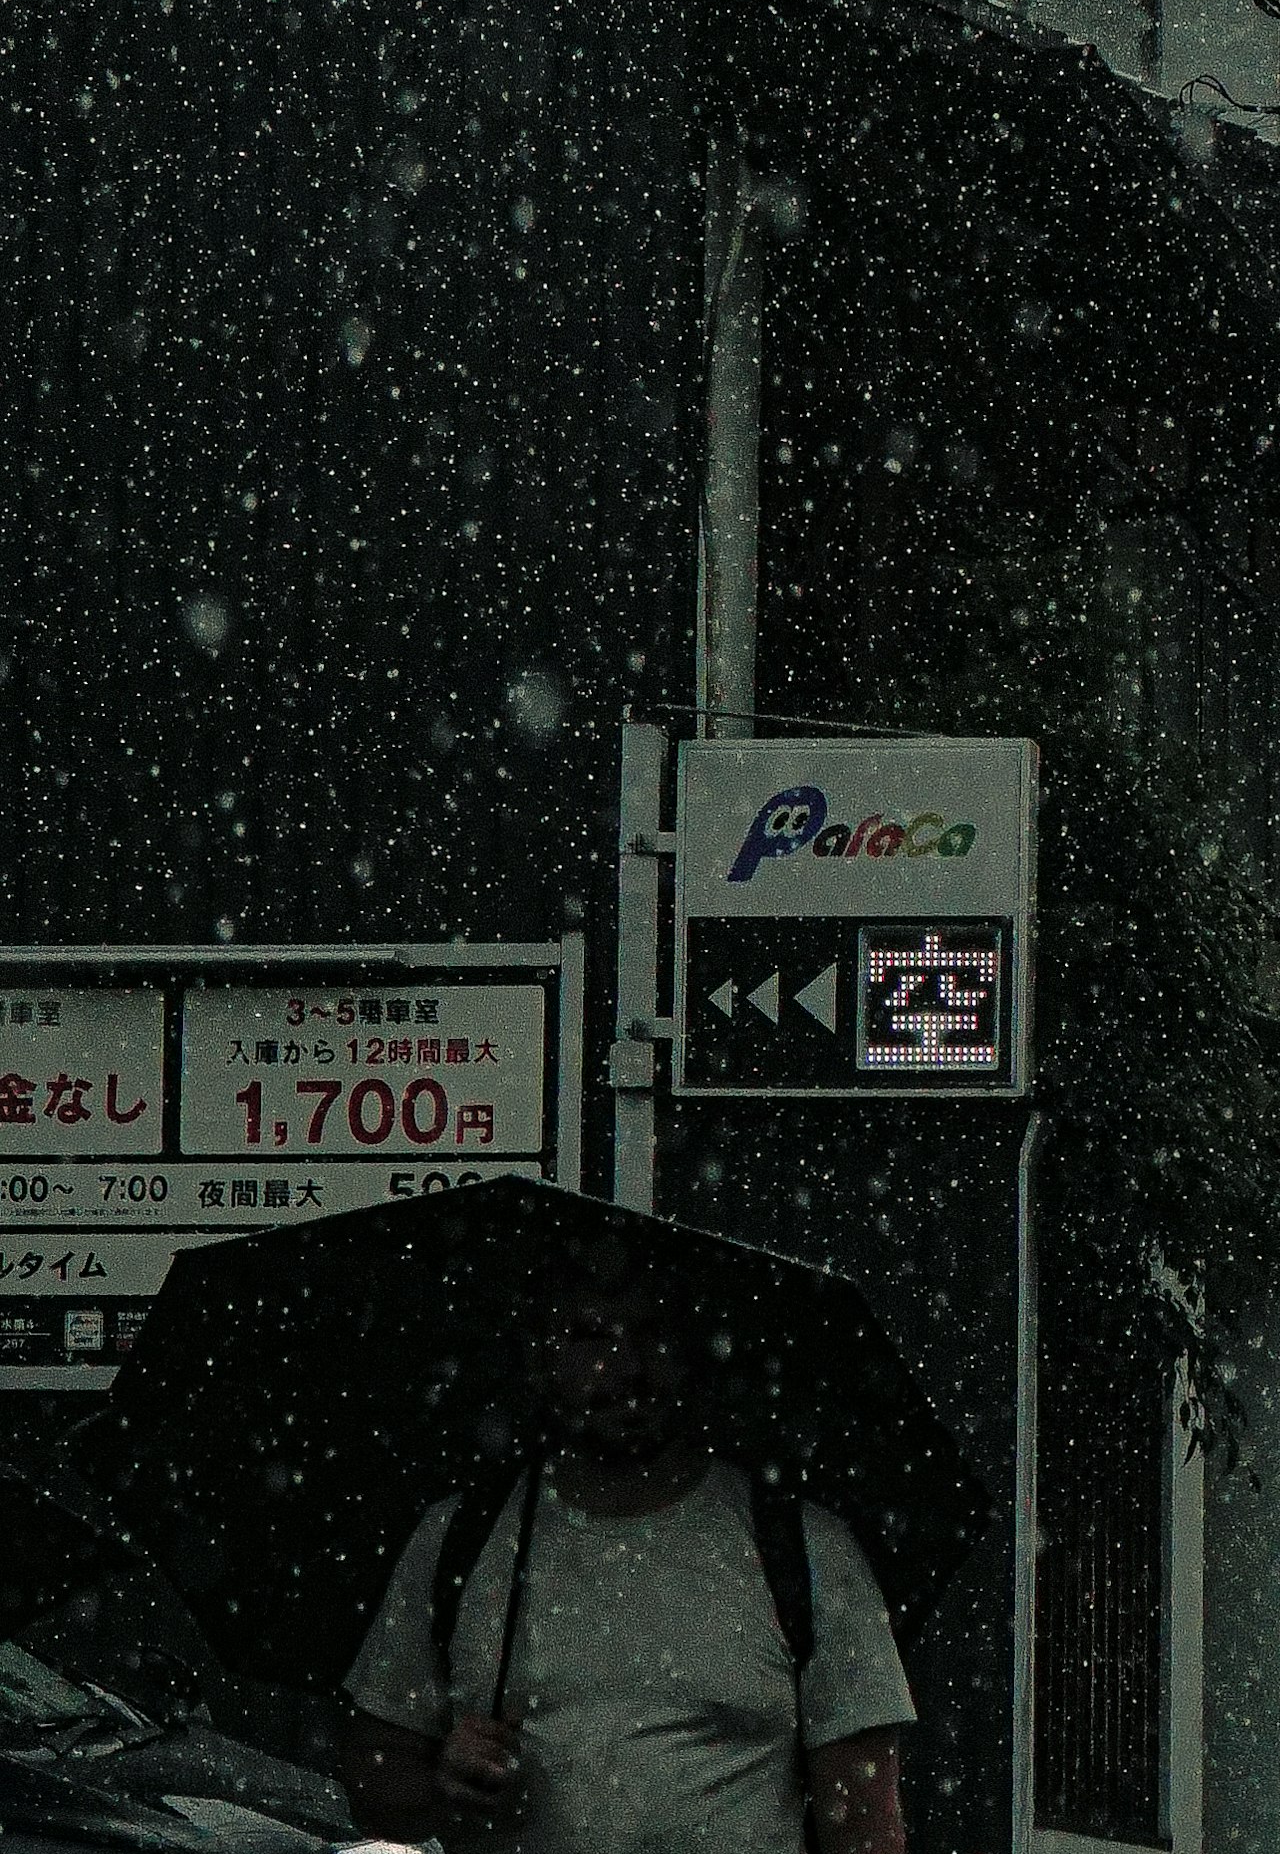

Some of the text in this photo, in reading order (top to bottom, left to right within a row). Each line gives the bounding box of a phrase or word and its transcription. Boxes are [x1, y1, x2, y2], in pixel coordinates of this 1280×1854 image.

[0, 1001, 61, 1027] 車室
[867, 934, 995, 1063] 空
[347, 1037, 499, 1065] 12時間最大
[236, 1077, 494, 1145] 1,700円
[99, 1175, 168, 1203] 7:00
[198, 1180, 324, 1209] 夜間最大
